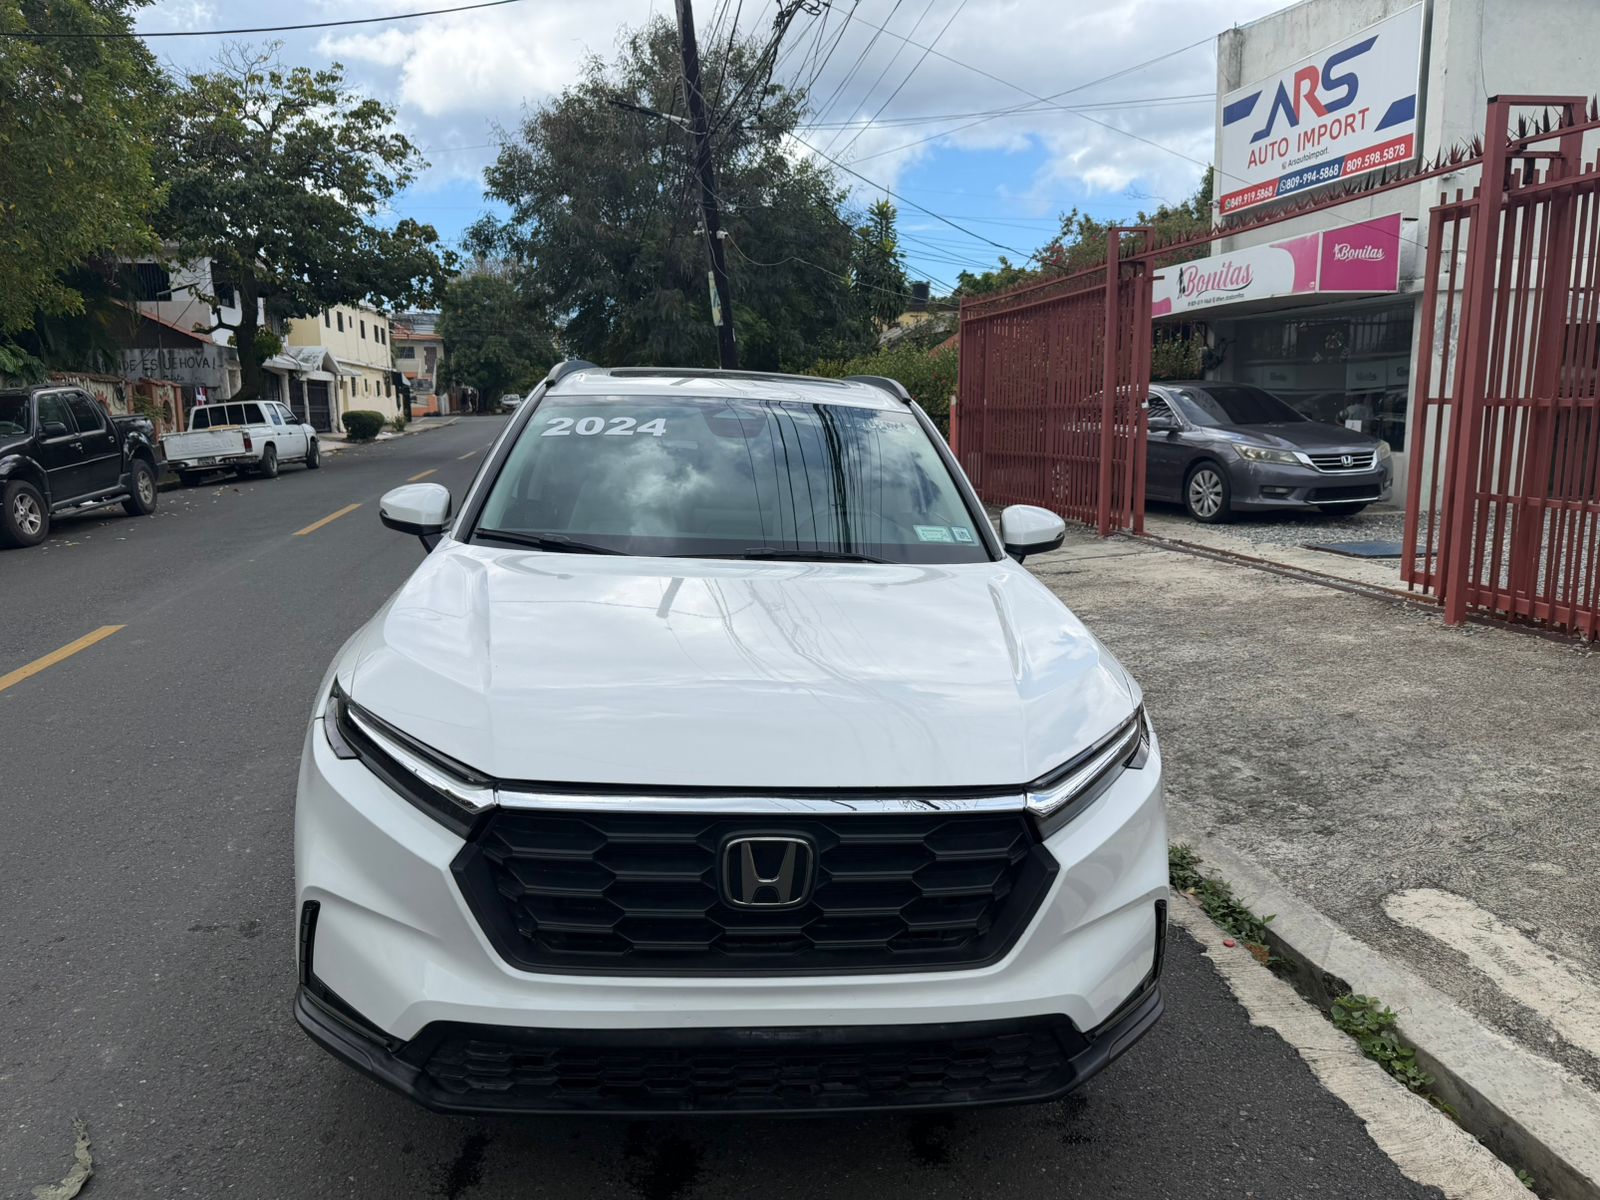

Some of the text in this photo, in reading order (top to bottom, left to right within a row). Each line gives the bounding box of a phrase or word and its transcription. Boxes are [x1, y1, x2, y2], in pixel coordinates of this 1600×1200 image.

[1250, 34, 1380, 144] ARS
[1247, 107, 1370, 169] AUTO IMPORT
[1346, 143, 1406, 172] 809.598.5878
[1338, 243, 1385, 261] Bonitas
[1182, 260, 1253, 297] Bonitas
[541, 416, 667, 437] 2024
